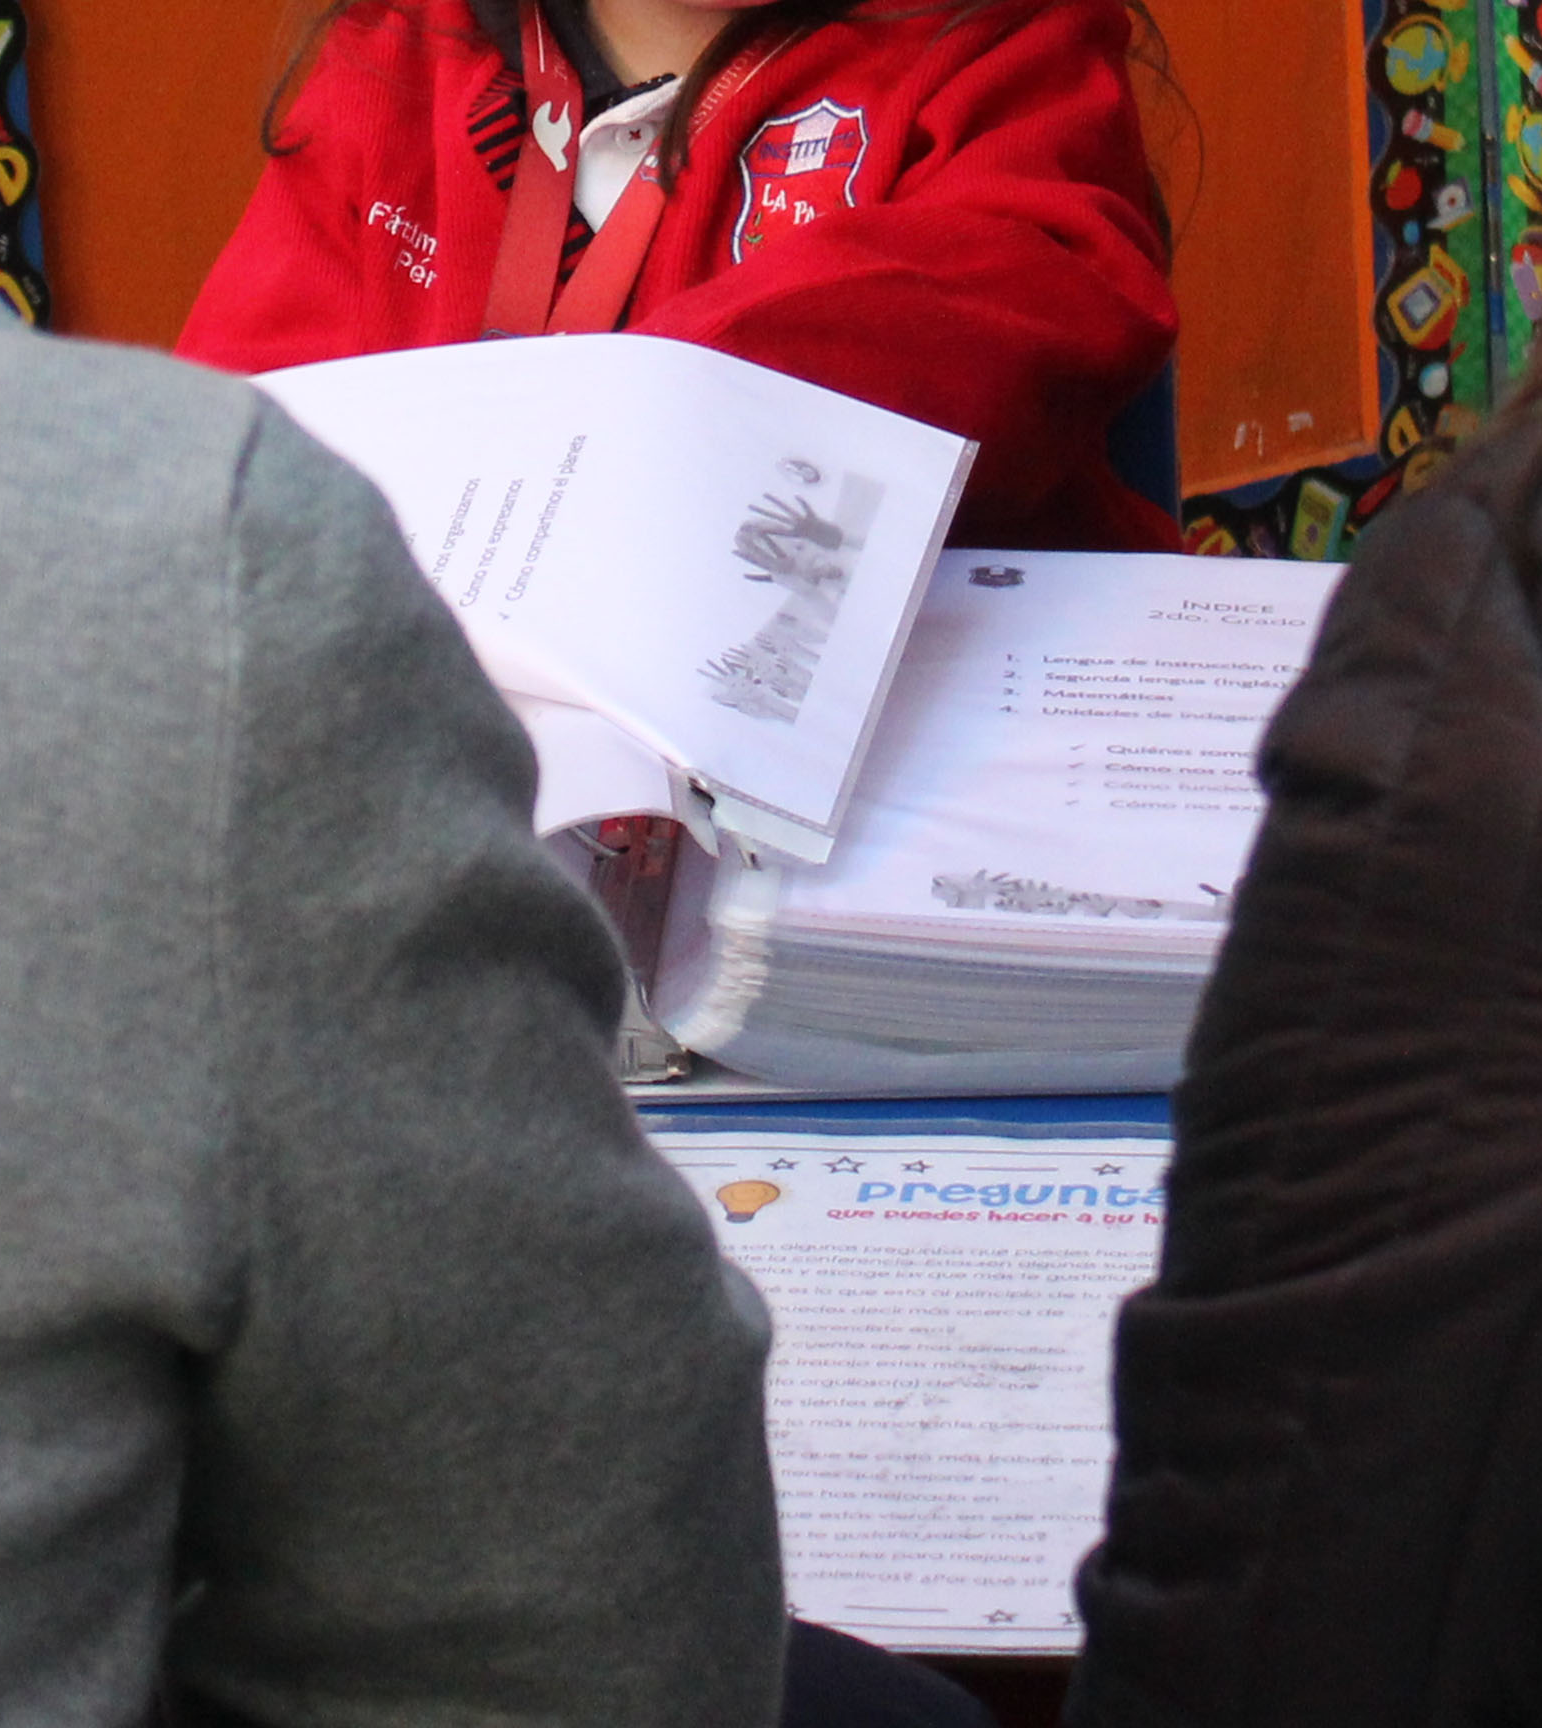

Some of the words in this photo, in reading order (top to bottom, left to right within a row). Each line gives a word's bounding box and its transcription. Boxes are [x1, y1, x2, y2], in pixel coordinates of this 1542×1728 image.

[761, 183, 787, 213] LA
[557, 434, 588, 475] planeta
[552, 477, 570, 488] el
[442, 477, 482, 551] organizamos
[487, 478, 525, 545] expresamos
[524, 490, 565, 563] compartimos
[478, 546, 498, 568] nos
[458, 570, 488, 608] Cómo
[504, 565, 534, 602] Cómo
[1146, 608, 1210, 624] 2do.
[1220, 614, 1307, 627] Grado
[1042, 655, 1116, 667] Lengua
[1121, 657, 1148, 667] de
[1044, 671, 1131, 684] Segunda
[1138, 674, 1207, 687] lengua
[1042, 689, 1175, 702] Matemáticas
[1041, 706, 1140, 718] Unidades
[1145, 710, 1174, 720] de
[1105, 744, 1193, 757] Quiénes
[1104, 763, 1172, 775] Cómo
[1178, 767, 1216, 776] nos
[1103, 781, 1173, 791] Cómo
[1108, 800, 1178, 811] Cómo
[987, 1210, 1069, 1223] hacer
[1075, 1212, 1094, 1224] a
[1102, 1212, 1136, 1225] tu
[780, 1241, 858, 1257] algunas
